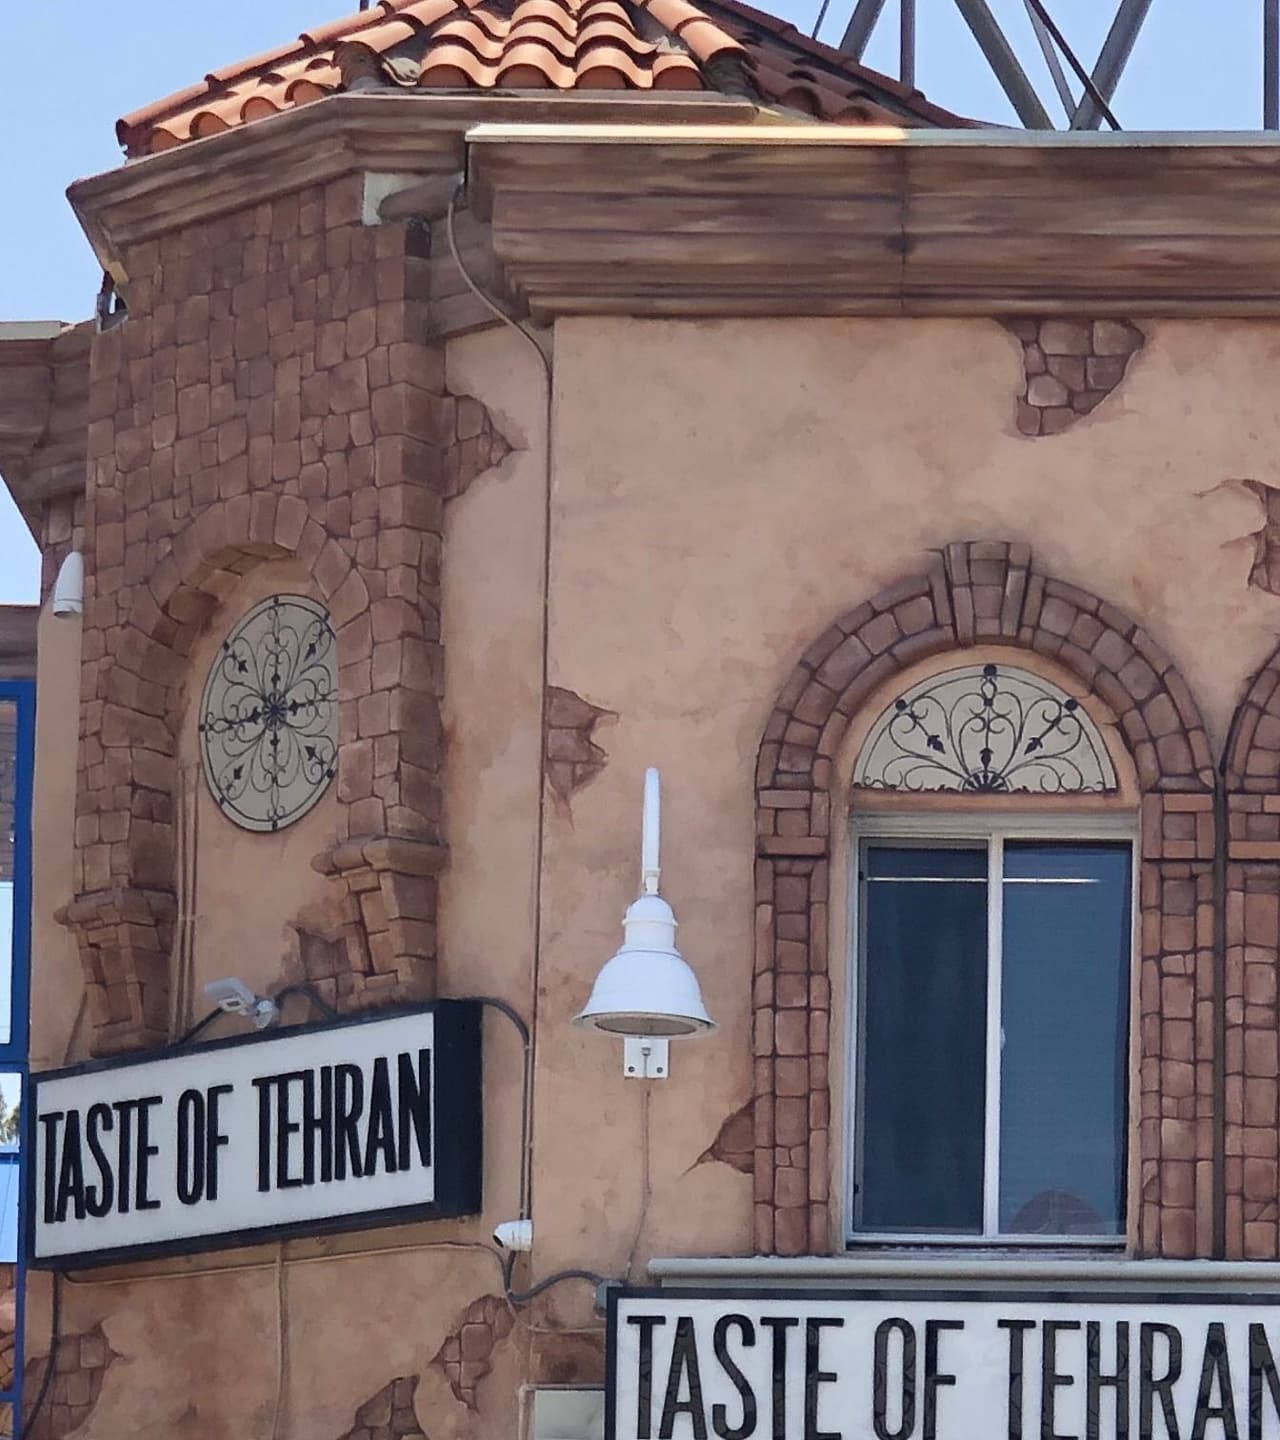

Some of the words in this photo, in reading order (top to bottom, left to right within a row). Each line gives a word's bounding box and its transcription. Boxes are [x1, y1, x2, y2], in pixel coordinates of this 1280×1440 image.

[39, 1096, 162, 1224] TASTE
[177, 1084, 234, 1205] OF
[252, 1048, 431, 1192] TEHRAN
